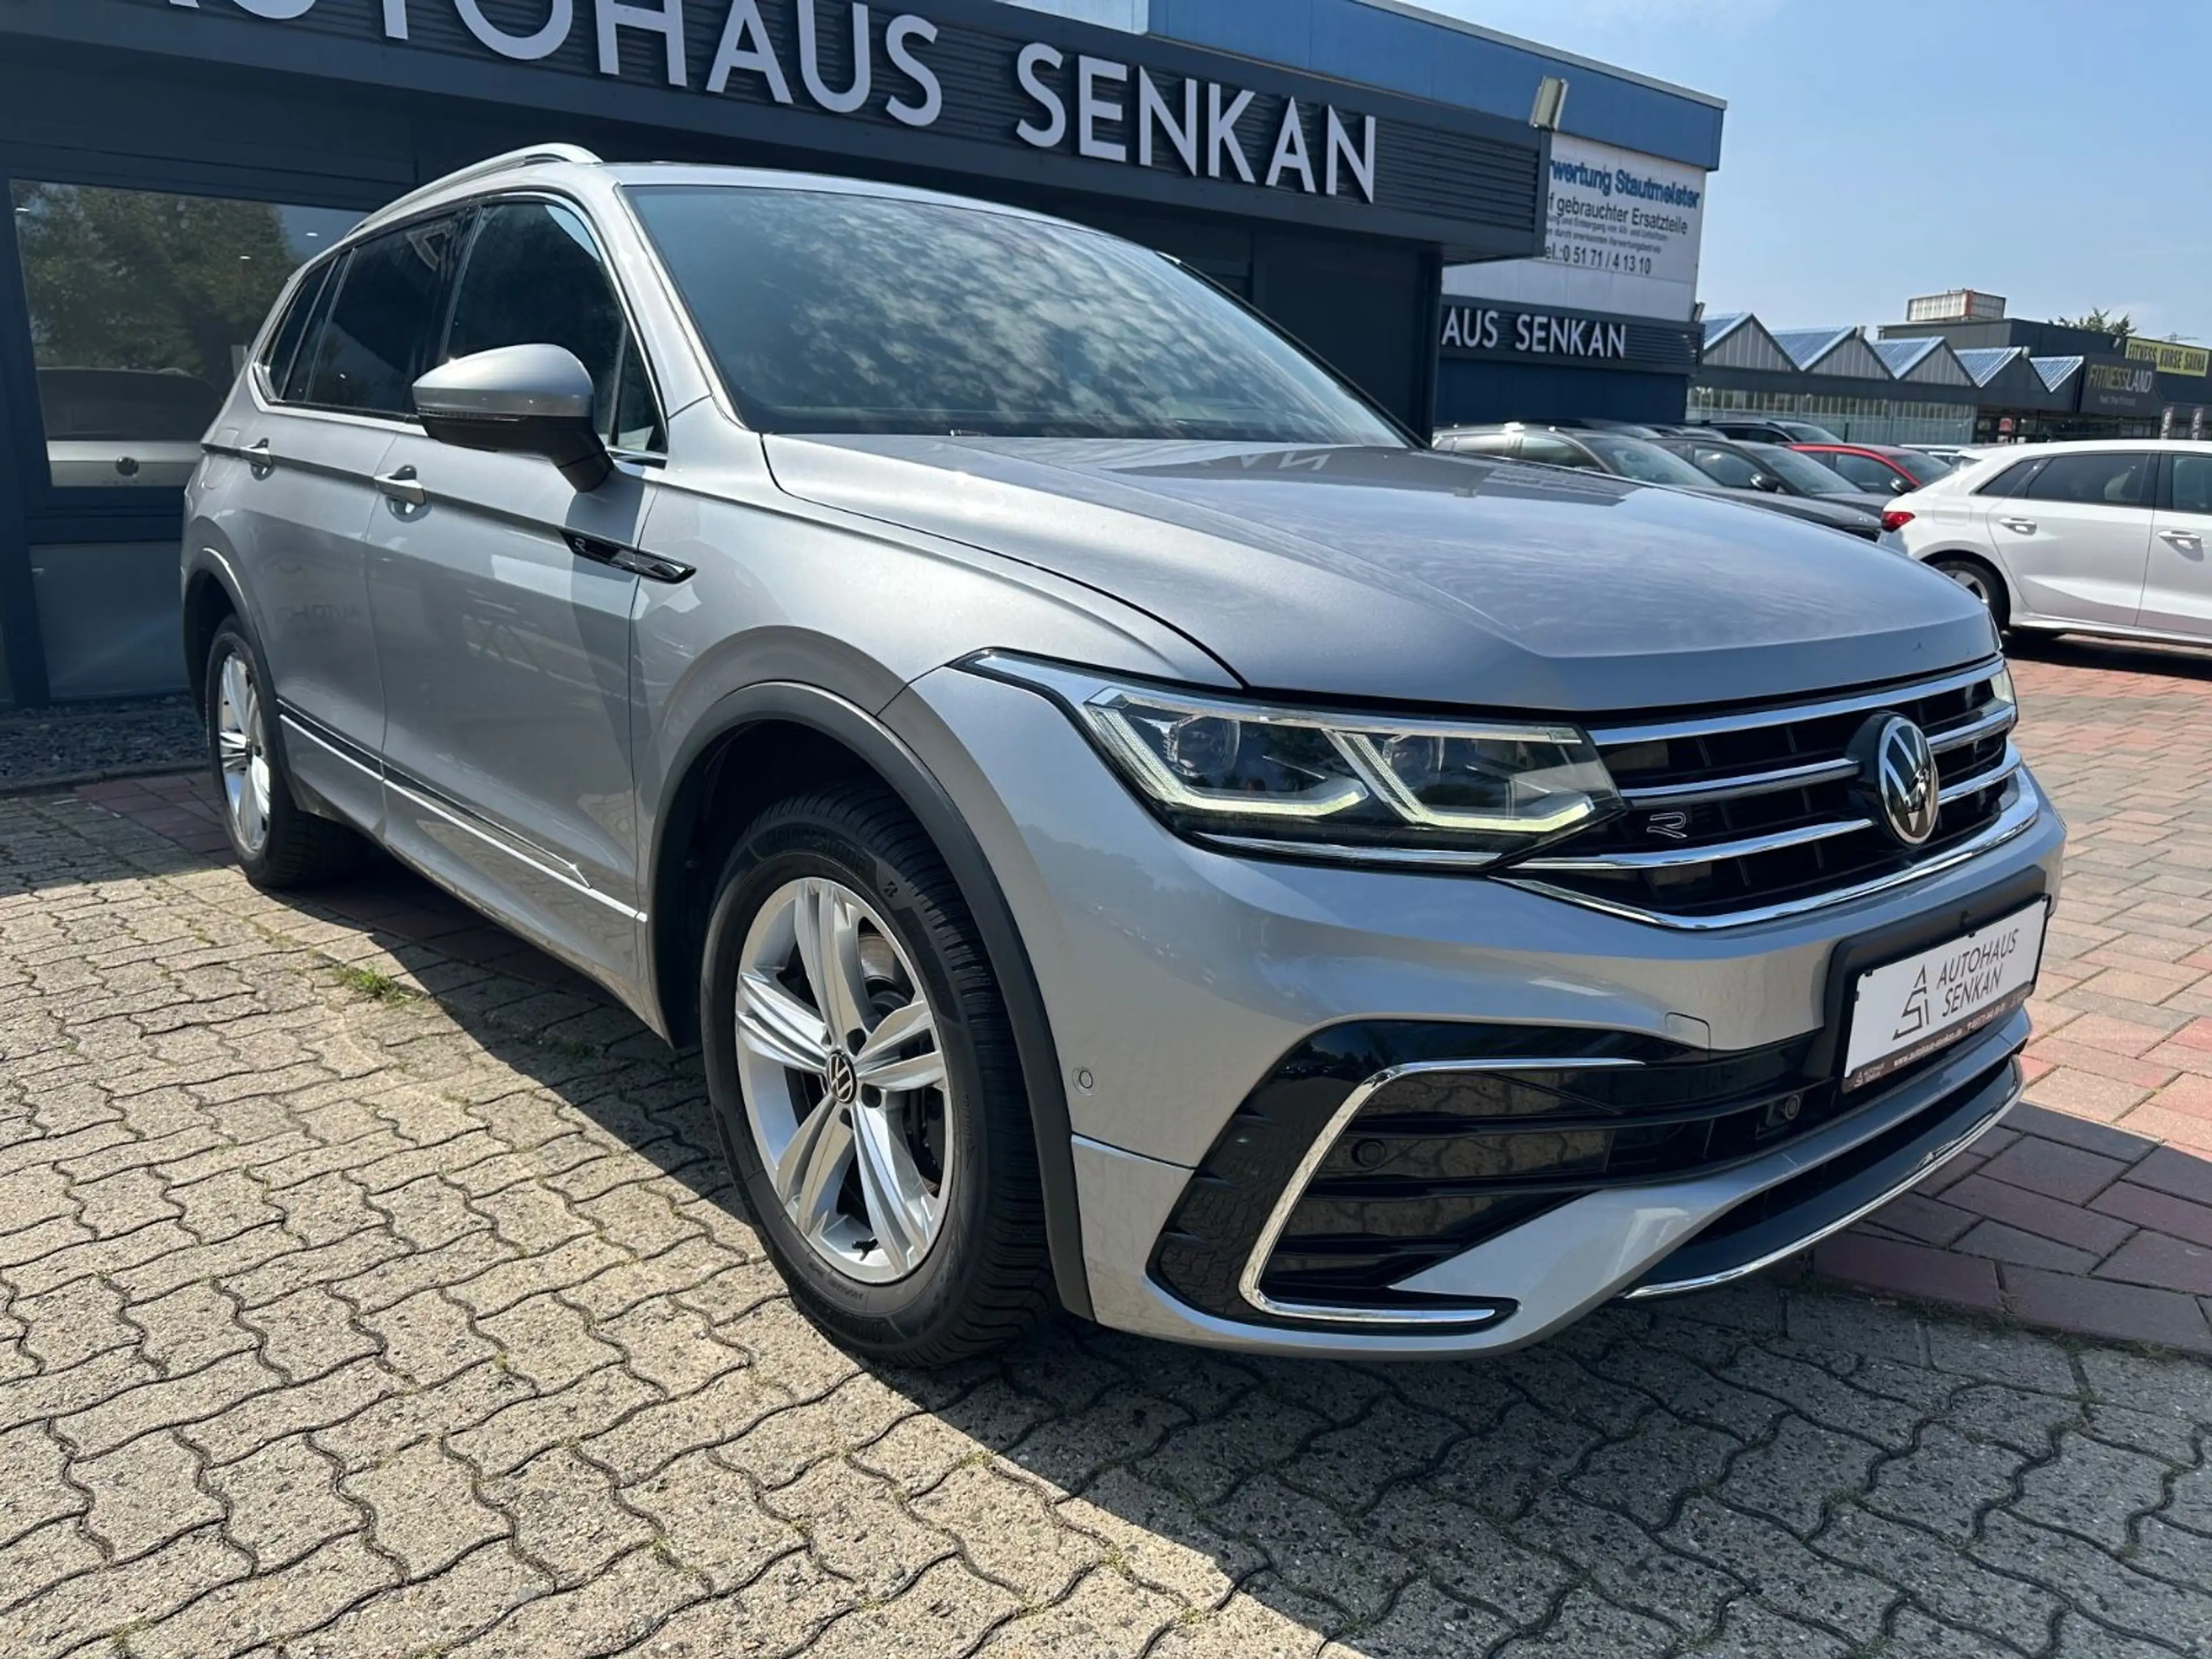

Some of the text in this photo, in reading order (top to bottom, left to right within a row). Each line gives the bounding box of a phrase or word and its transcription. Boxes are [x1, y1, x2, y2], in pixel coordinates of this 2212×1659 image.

[1017, 43, 1376, 204] SENKAN
[1556, 196, 1628, 222] gebrauchter
[1631, 207, 1688, 235] Ersatzteile
[1624, 254, 1635, 272] 13
[1639, 257, 1650, 275] 10
[1515, 313, 1626, 358] SENKAN
[1936, 929, 2019, 990] AUTOHAUS
[1942, 962, 2003, 1017] SENKAN
